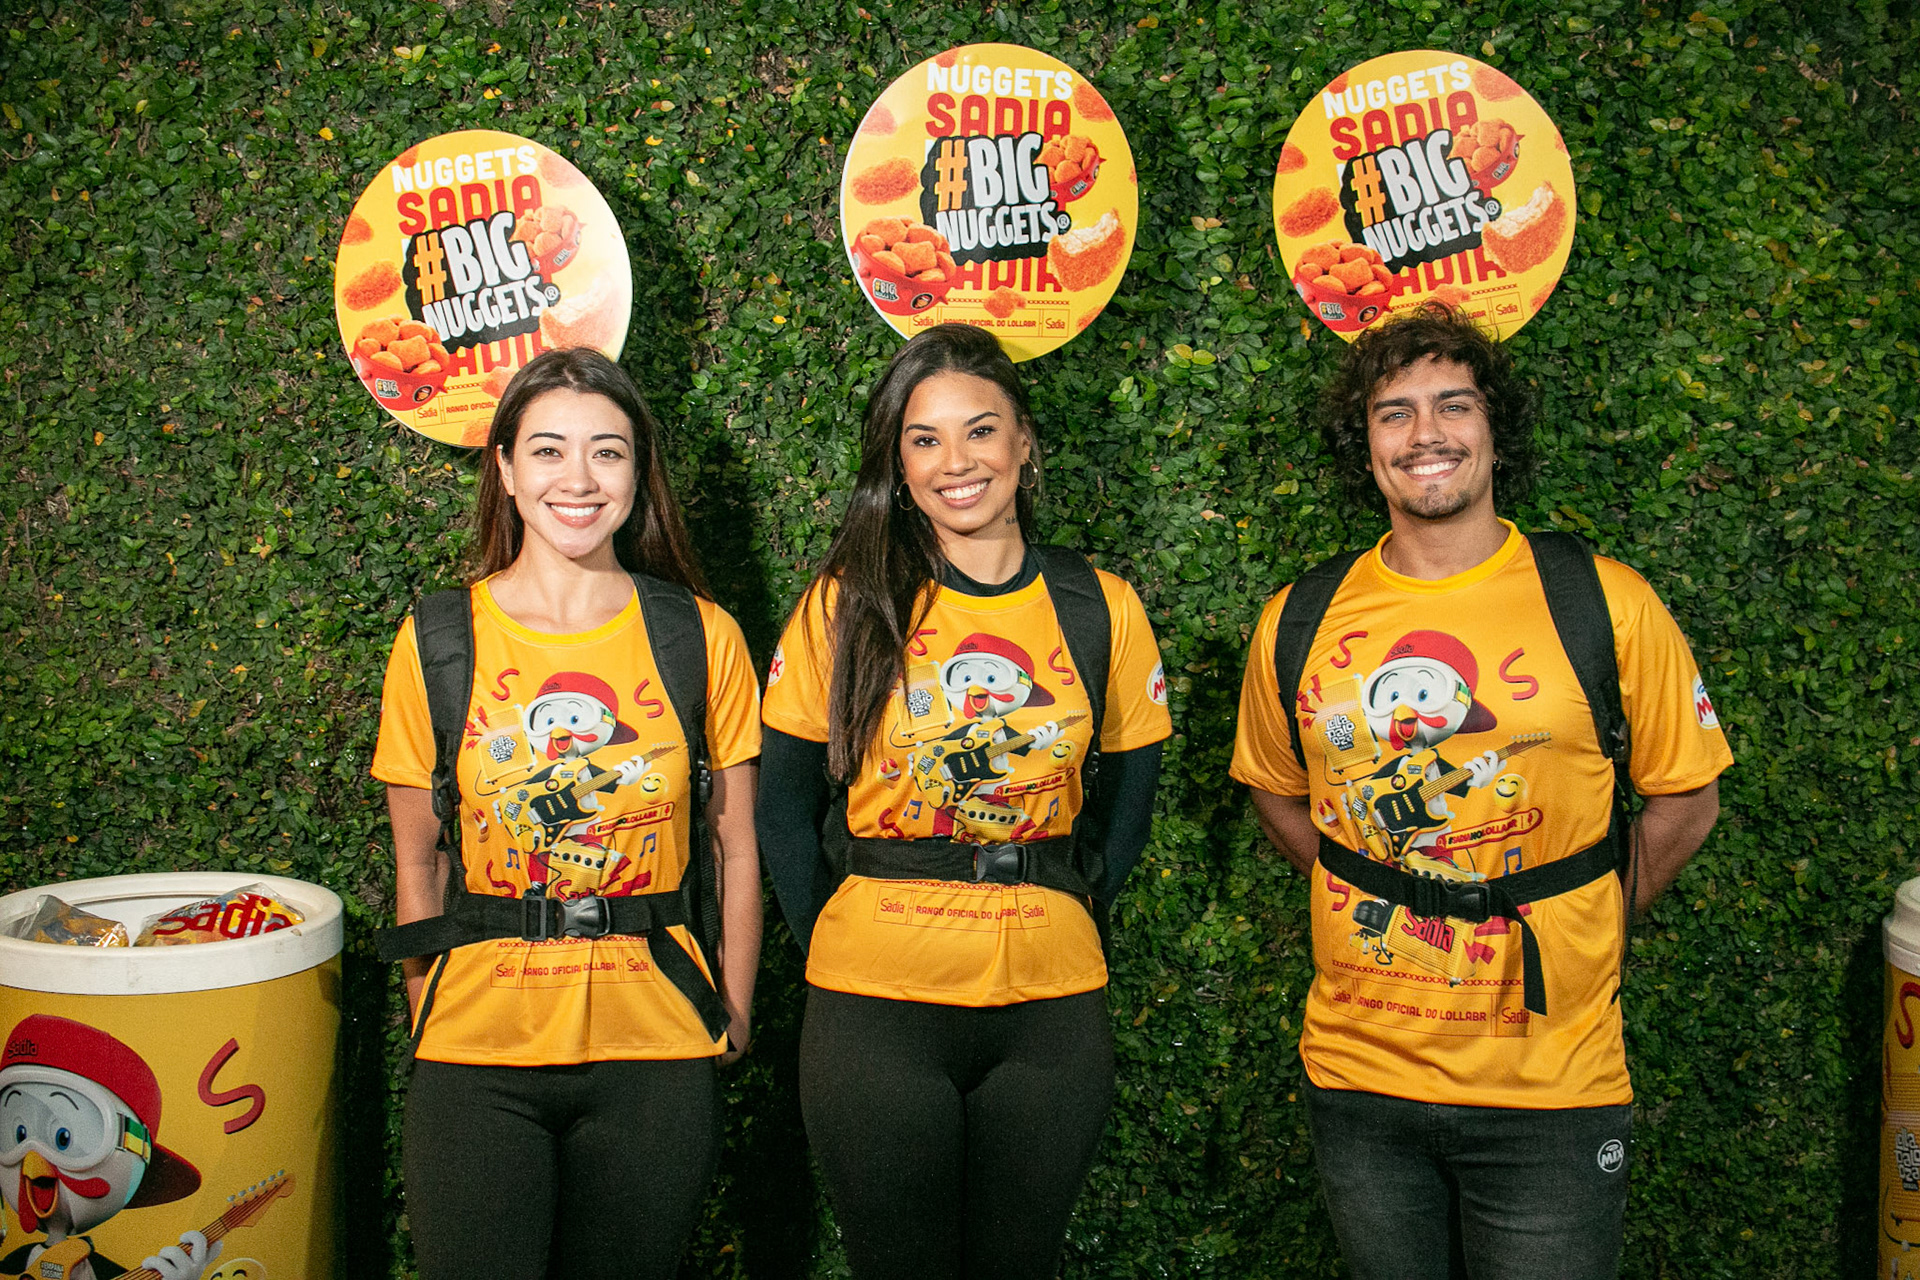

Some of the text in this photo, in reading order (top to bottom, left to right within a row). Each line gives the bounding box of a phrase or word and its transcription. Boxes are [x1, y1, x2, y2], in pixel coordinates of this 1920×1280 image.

[927, 63, 1073, 100] NUGGETS
[1322, 61, 1472, 119] NUGGETS
[925, 93, 1071, 140] SADIA
[1329, 91, 1479, 161] SADIA
[391, 145, 538, 193] NUGGETS
[935, 132, 1051, 211] #BIG
[1352, 130, 1471, 227] #BIG
[397, 174, 543, 236] SADIA
[414, 211, 531, 305] #BIG
[952, 256, 1063, 293] ADIA
[1391, 245, 1507, 297] ADIA
[912, 315, 934, 327] Sadia
[1045, 318, 1065, 330] Sadia
[1495, 304, 1518, 315] Sadia
[417, 401, 496, 419] Sadia RANGO OFICIAL
[880, 898, 905, 914] Sadia
[915, 905, 944, 916] RANGO
[947, 908, 979, 919] OFICIAL
[981, 910, 992, 919] DO
[1021, 904, 1045, 918] Sadia
[1401, 906, 1455, 954] Sadia
[1386, 1002, 1422, 1017] OFICIAL
[1425, 1008, 1437, 1019] DO
[1440, 1009, 1486, 1022] LOLLABR
[1502, 1006, 1530, 1024] Sadia
[7, 1038, 39, 1059] Sadia
